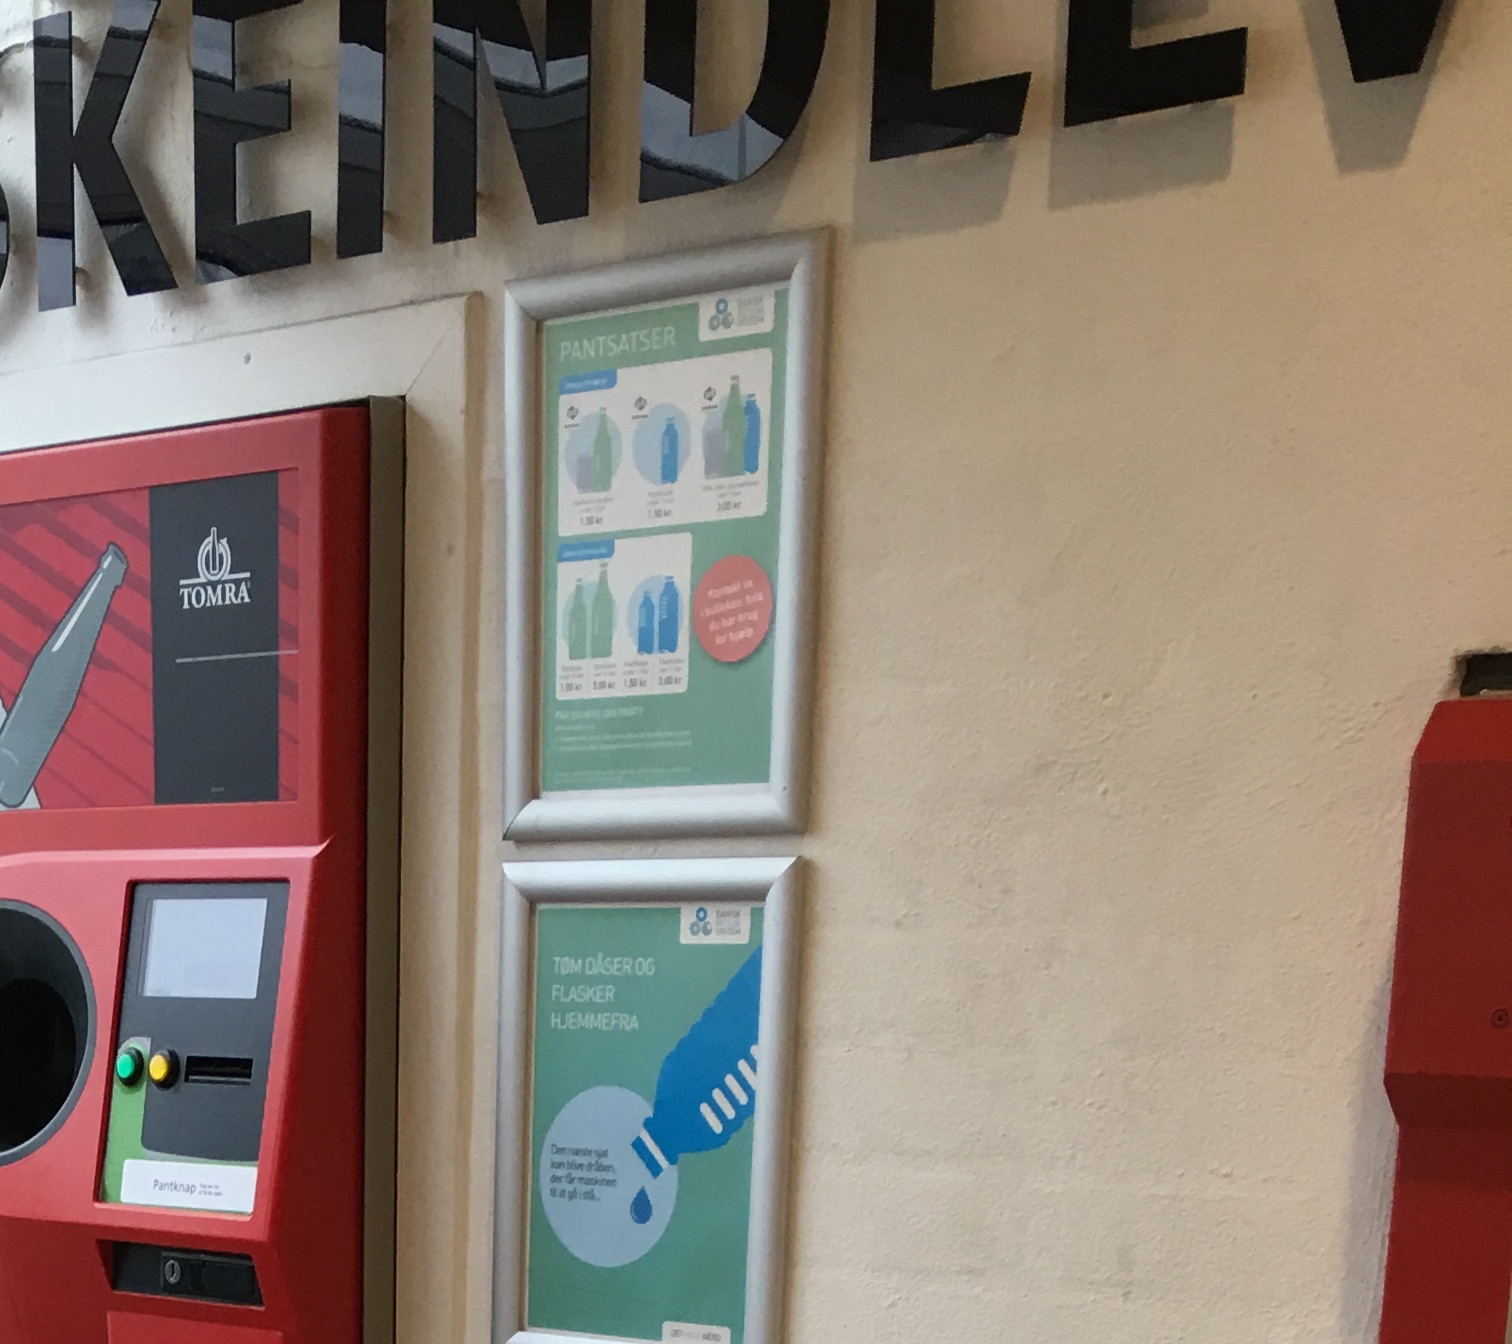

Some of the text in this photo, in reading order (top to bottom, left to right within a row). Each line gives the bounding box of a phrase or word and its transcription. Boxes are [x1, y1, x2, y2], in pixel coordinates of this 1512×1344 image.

[560, 326, 676, 362] PANTSATSER
[179, 581, 251, 609] TOMRA
[553, 951, 655, 976] TØM DÅSER OG
[551, 984, 615, 1003] FLASKER
[551, 1012, 638, 1031] HJEMMEFRA
[153, 1178, 197, 1196] Pantknap
